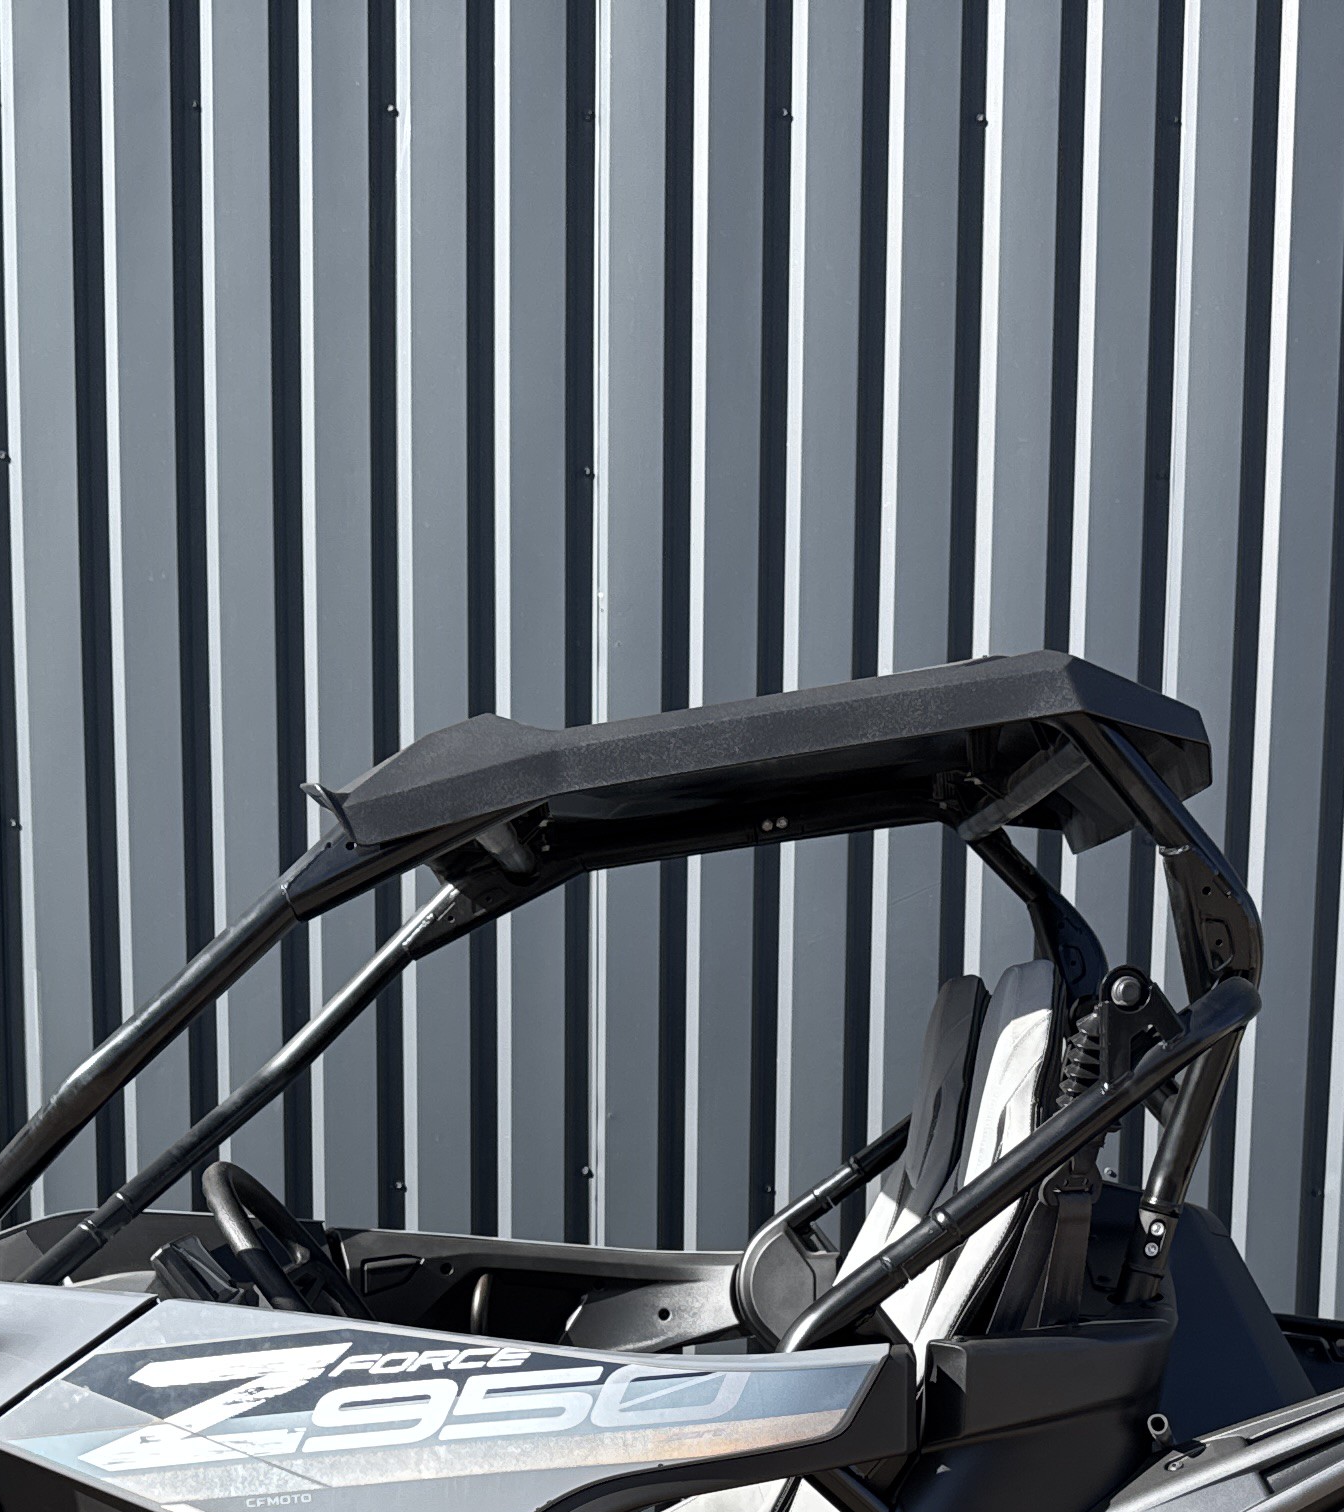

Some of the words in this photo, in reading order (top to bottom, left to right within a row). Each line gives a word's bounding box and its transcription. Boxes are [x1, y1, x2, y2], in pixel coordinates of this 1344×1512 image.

[327, 1346, 532, 1378] FORCE
[79, 1341, 353, 1472] Z
[300, 1365, 751, 1452] 950
[246, 1493, 312, 1508] CFMOTO
